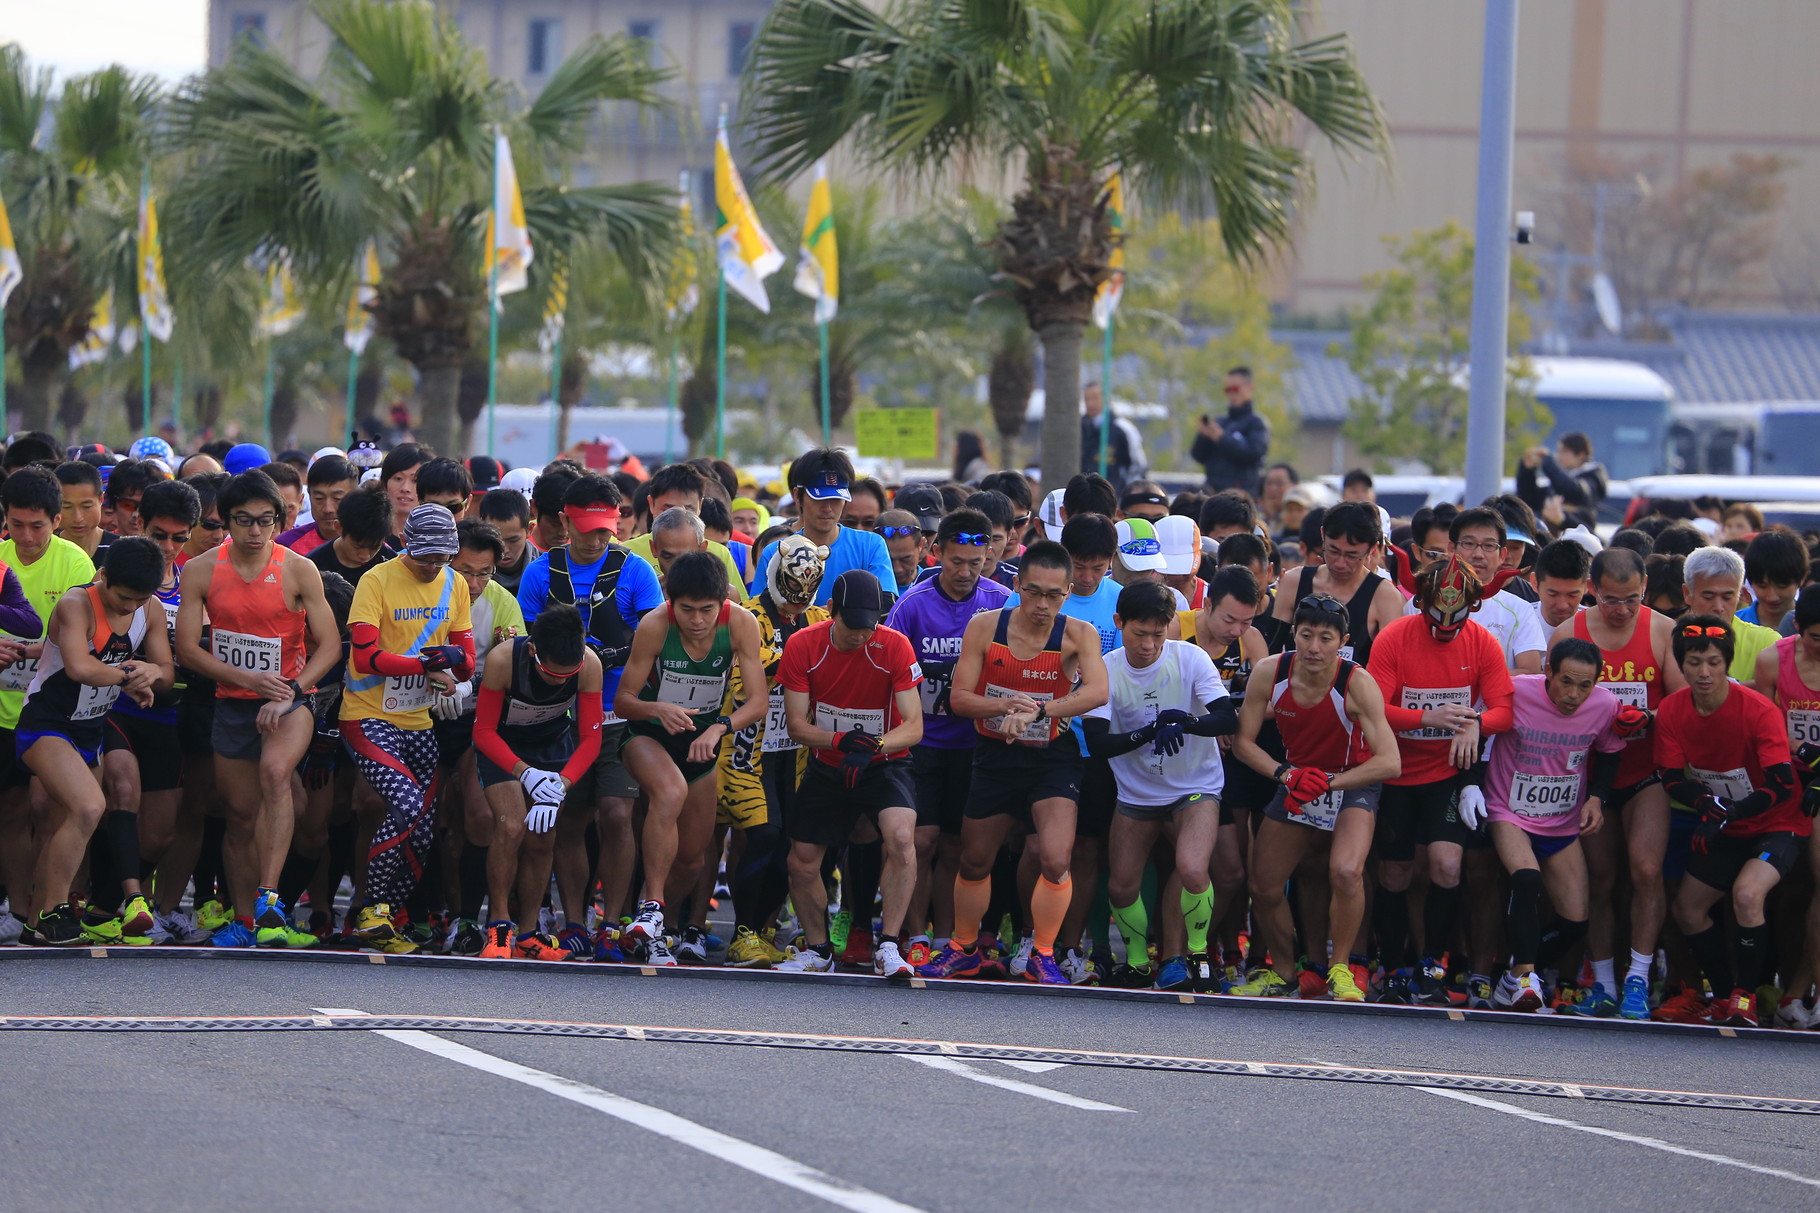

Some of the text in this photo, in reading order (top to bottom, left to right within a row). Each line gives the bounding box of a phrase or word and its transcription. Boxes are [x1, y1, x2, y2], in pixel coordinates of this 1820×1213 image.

[394, 607, 450, 621] NUMACCHI
[218, 645, 271, 671] 5005
[1022, 669, 1058, 681] 熊本CAC
[1516, 782, 1573, 804] 16004
